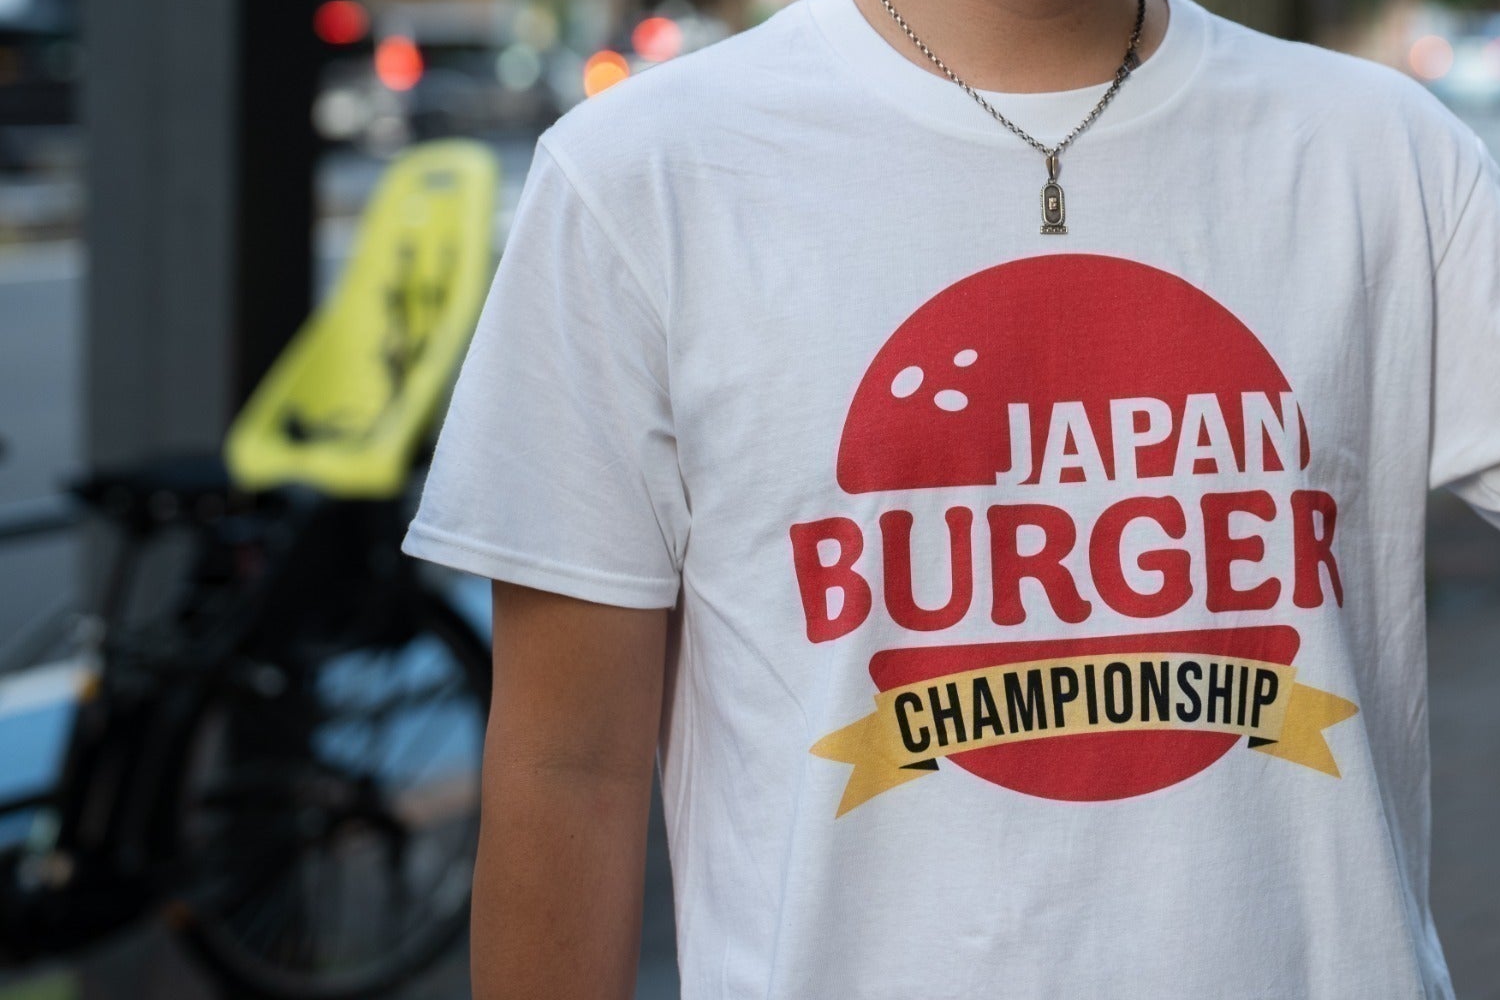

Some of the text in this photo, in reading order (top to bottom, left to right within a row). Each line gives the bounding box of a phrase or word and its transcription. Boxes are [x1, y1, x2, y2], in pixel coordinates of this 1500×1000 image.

[996, 391, 1303, 486] JAPAN
[789, 489, 1343, 643] BURGER
[894, 660, 1279, 753] CHAMPIONSHIP
